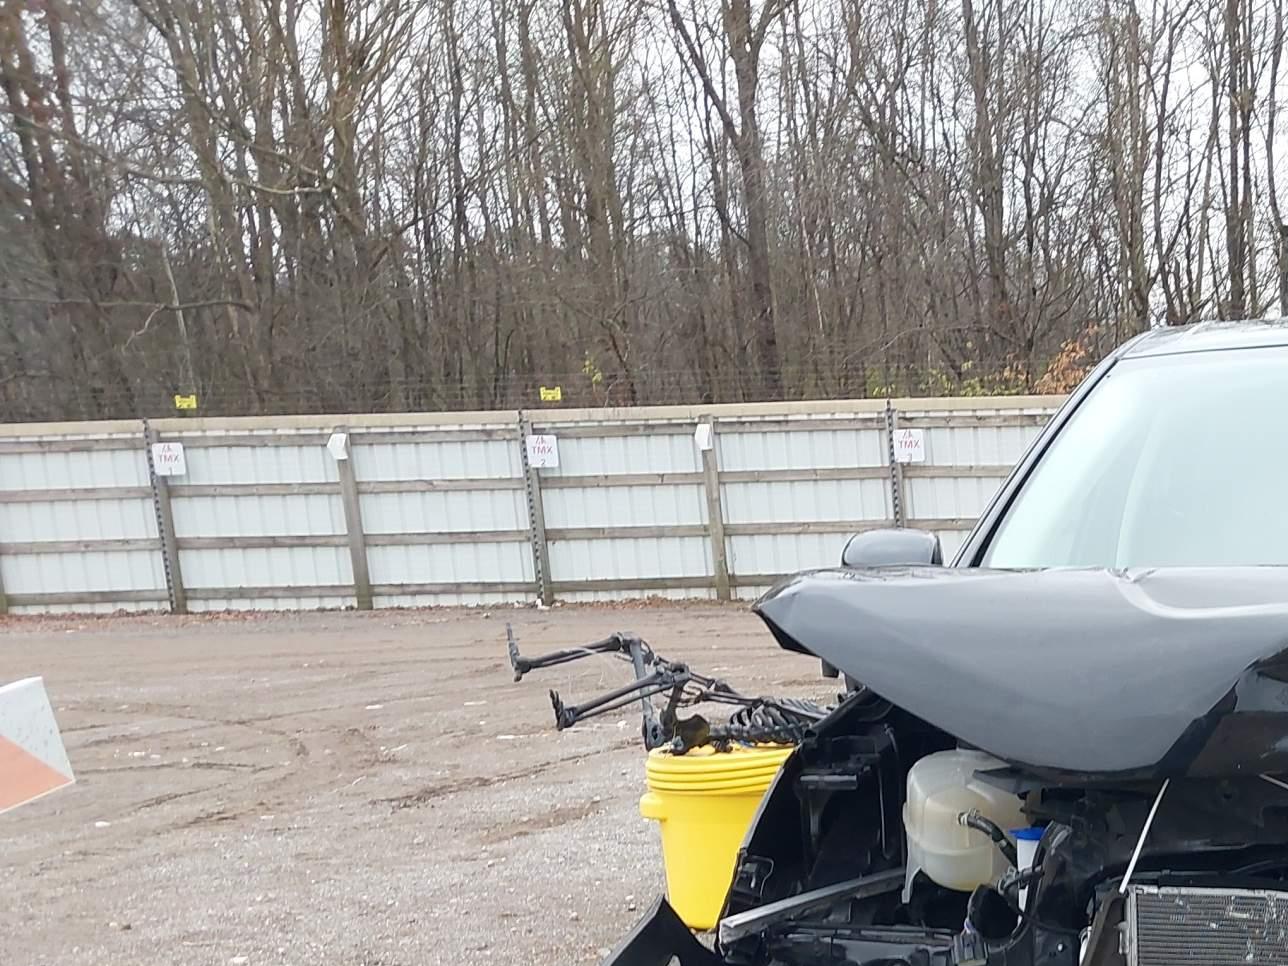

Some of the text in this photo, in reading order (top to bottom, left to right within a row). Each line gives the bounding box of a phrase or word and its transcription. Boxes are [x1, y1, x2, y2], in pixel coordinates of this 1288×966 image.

[898, 440, 921, 449] TMX
[532, 446, 553, 455] TMX
[159, 454, 180, 463] TMX
